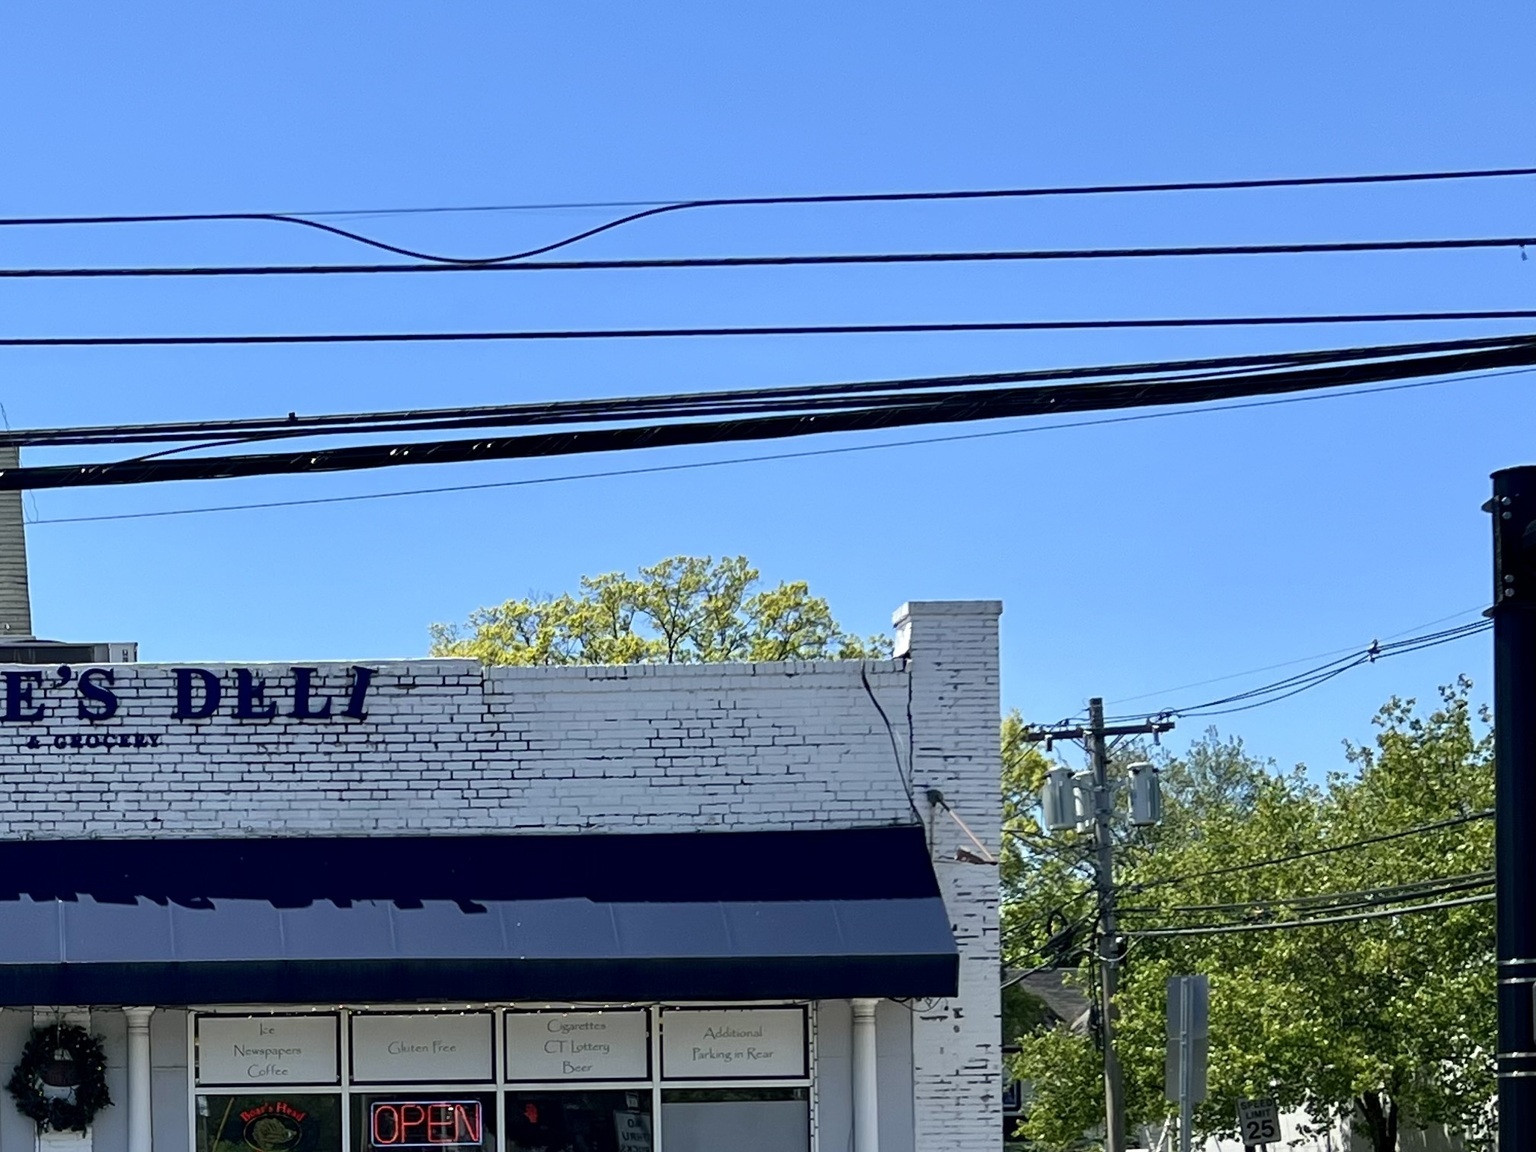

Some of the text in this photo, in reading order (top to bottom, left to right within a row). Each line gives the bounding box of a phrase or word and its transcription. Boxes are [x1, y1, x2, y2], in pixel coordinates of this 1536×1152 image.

[170, 665, 380, 723] DELI
[54, 735, 161, 749] GROCERY
[259, 1022, 276, 1036] Ice
[547, 1018, 607, 1035] Cigarettes
[703, 1025, 763, 1040] Additional
[233, 1044, 302, 1060] Newspapers
[387, 1040, 457, 1055] Gluten Free
[544, 1039, 610, 1055] CT Lottery
[692, 1046, 774, 1063] Parking in Rear
[247, 1063, 289, 1079] Coffee
[562, 1060, 593, 1075] Beer
[240, 1101, 306, 1122] Boar's Head
[1240, 1099, 1273, 1110] SPEED
[1246, 1109, 1271, 1119] LIMIT
[374, 1104, 479, 1143] OPEN
[1246, 1119, 1275, 1139] 25
